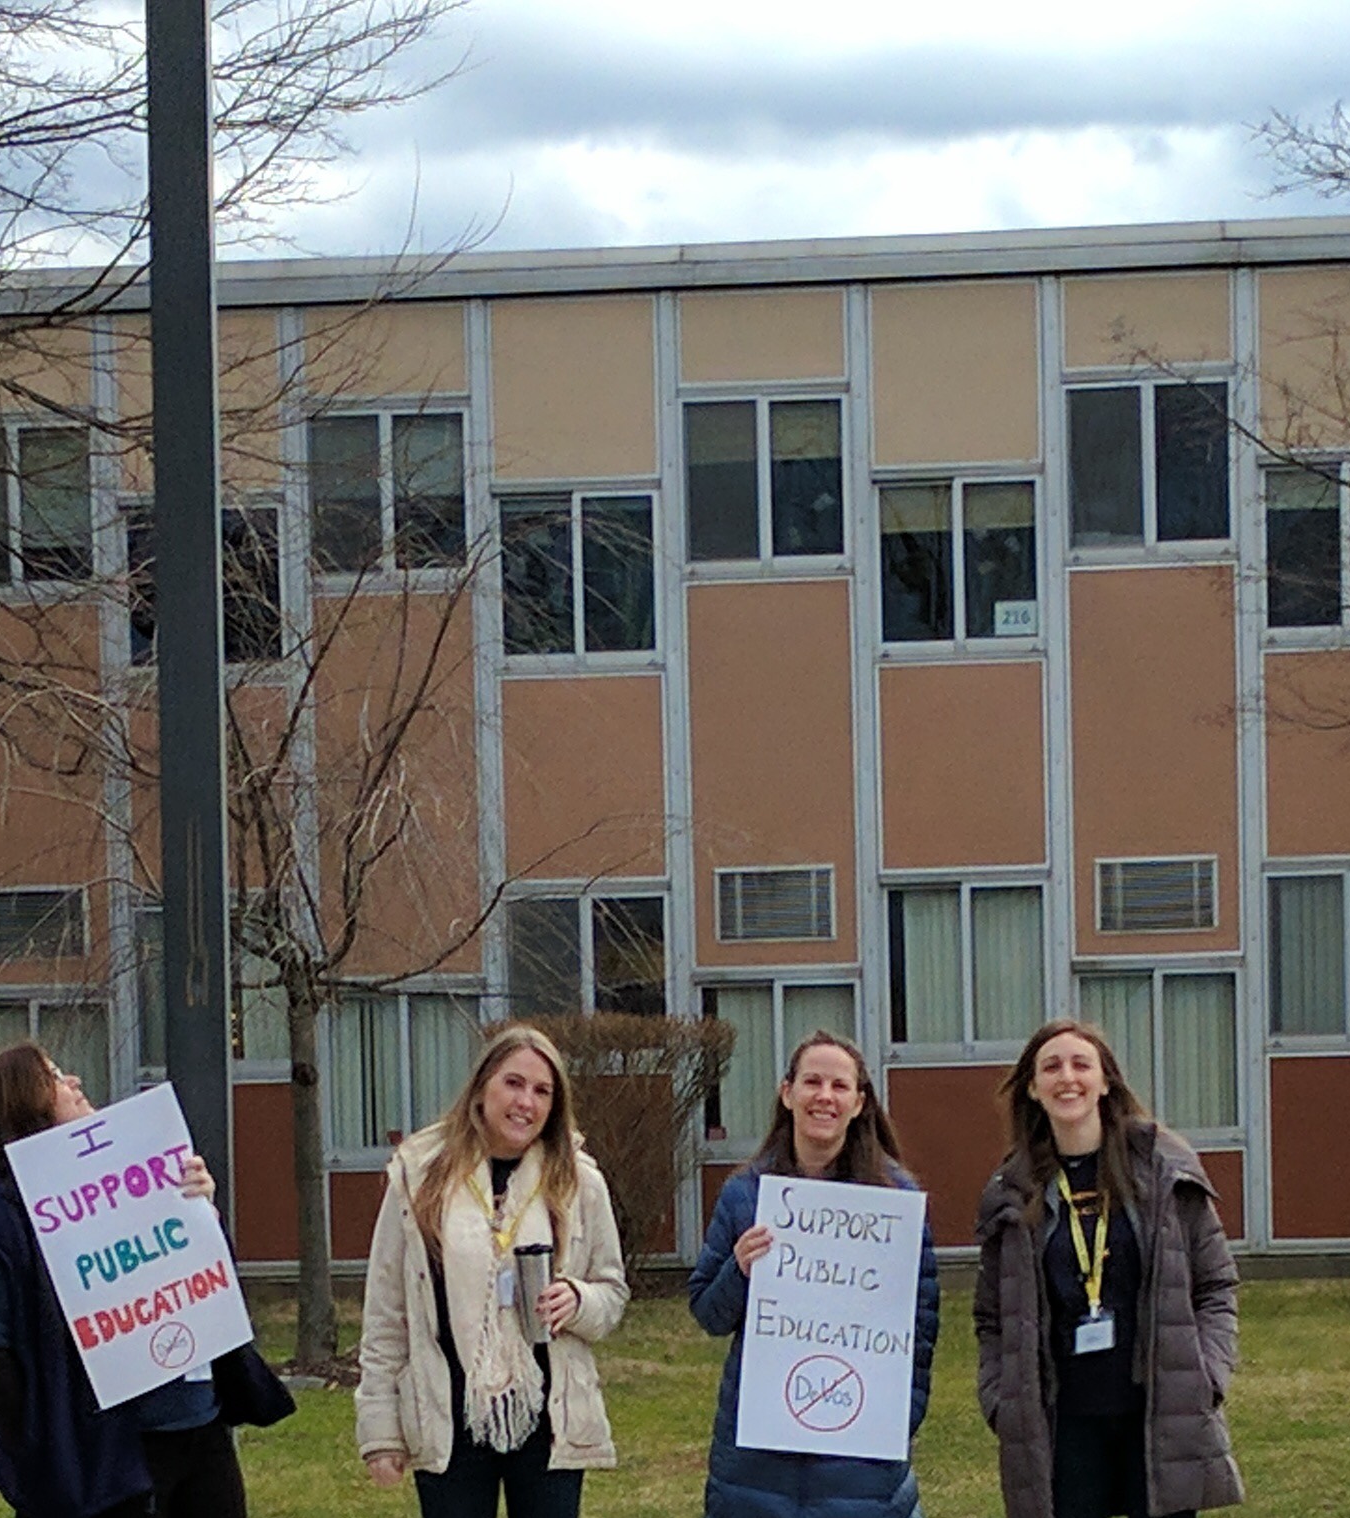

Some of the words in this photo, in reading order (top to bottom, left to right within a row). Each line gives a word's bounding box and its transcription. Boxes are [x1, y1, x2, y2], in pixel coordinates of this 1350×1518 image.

[1002, 610, 1031, 625] 216
[68, 1119, 114, 1158] I
[33, 1143, 189, 1234] SUPPORT
[774, 1186, 901, 1244] SUPPORT
[75, 1217, 190, 1291] PUBLIC
[776, 1242, 880, 1291] PUBLIC
[72, 1259, 230, 1351] EDUCATION
[754, 1298, 911, 1356] EDUCATION
